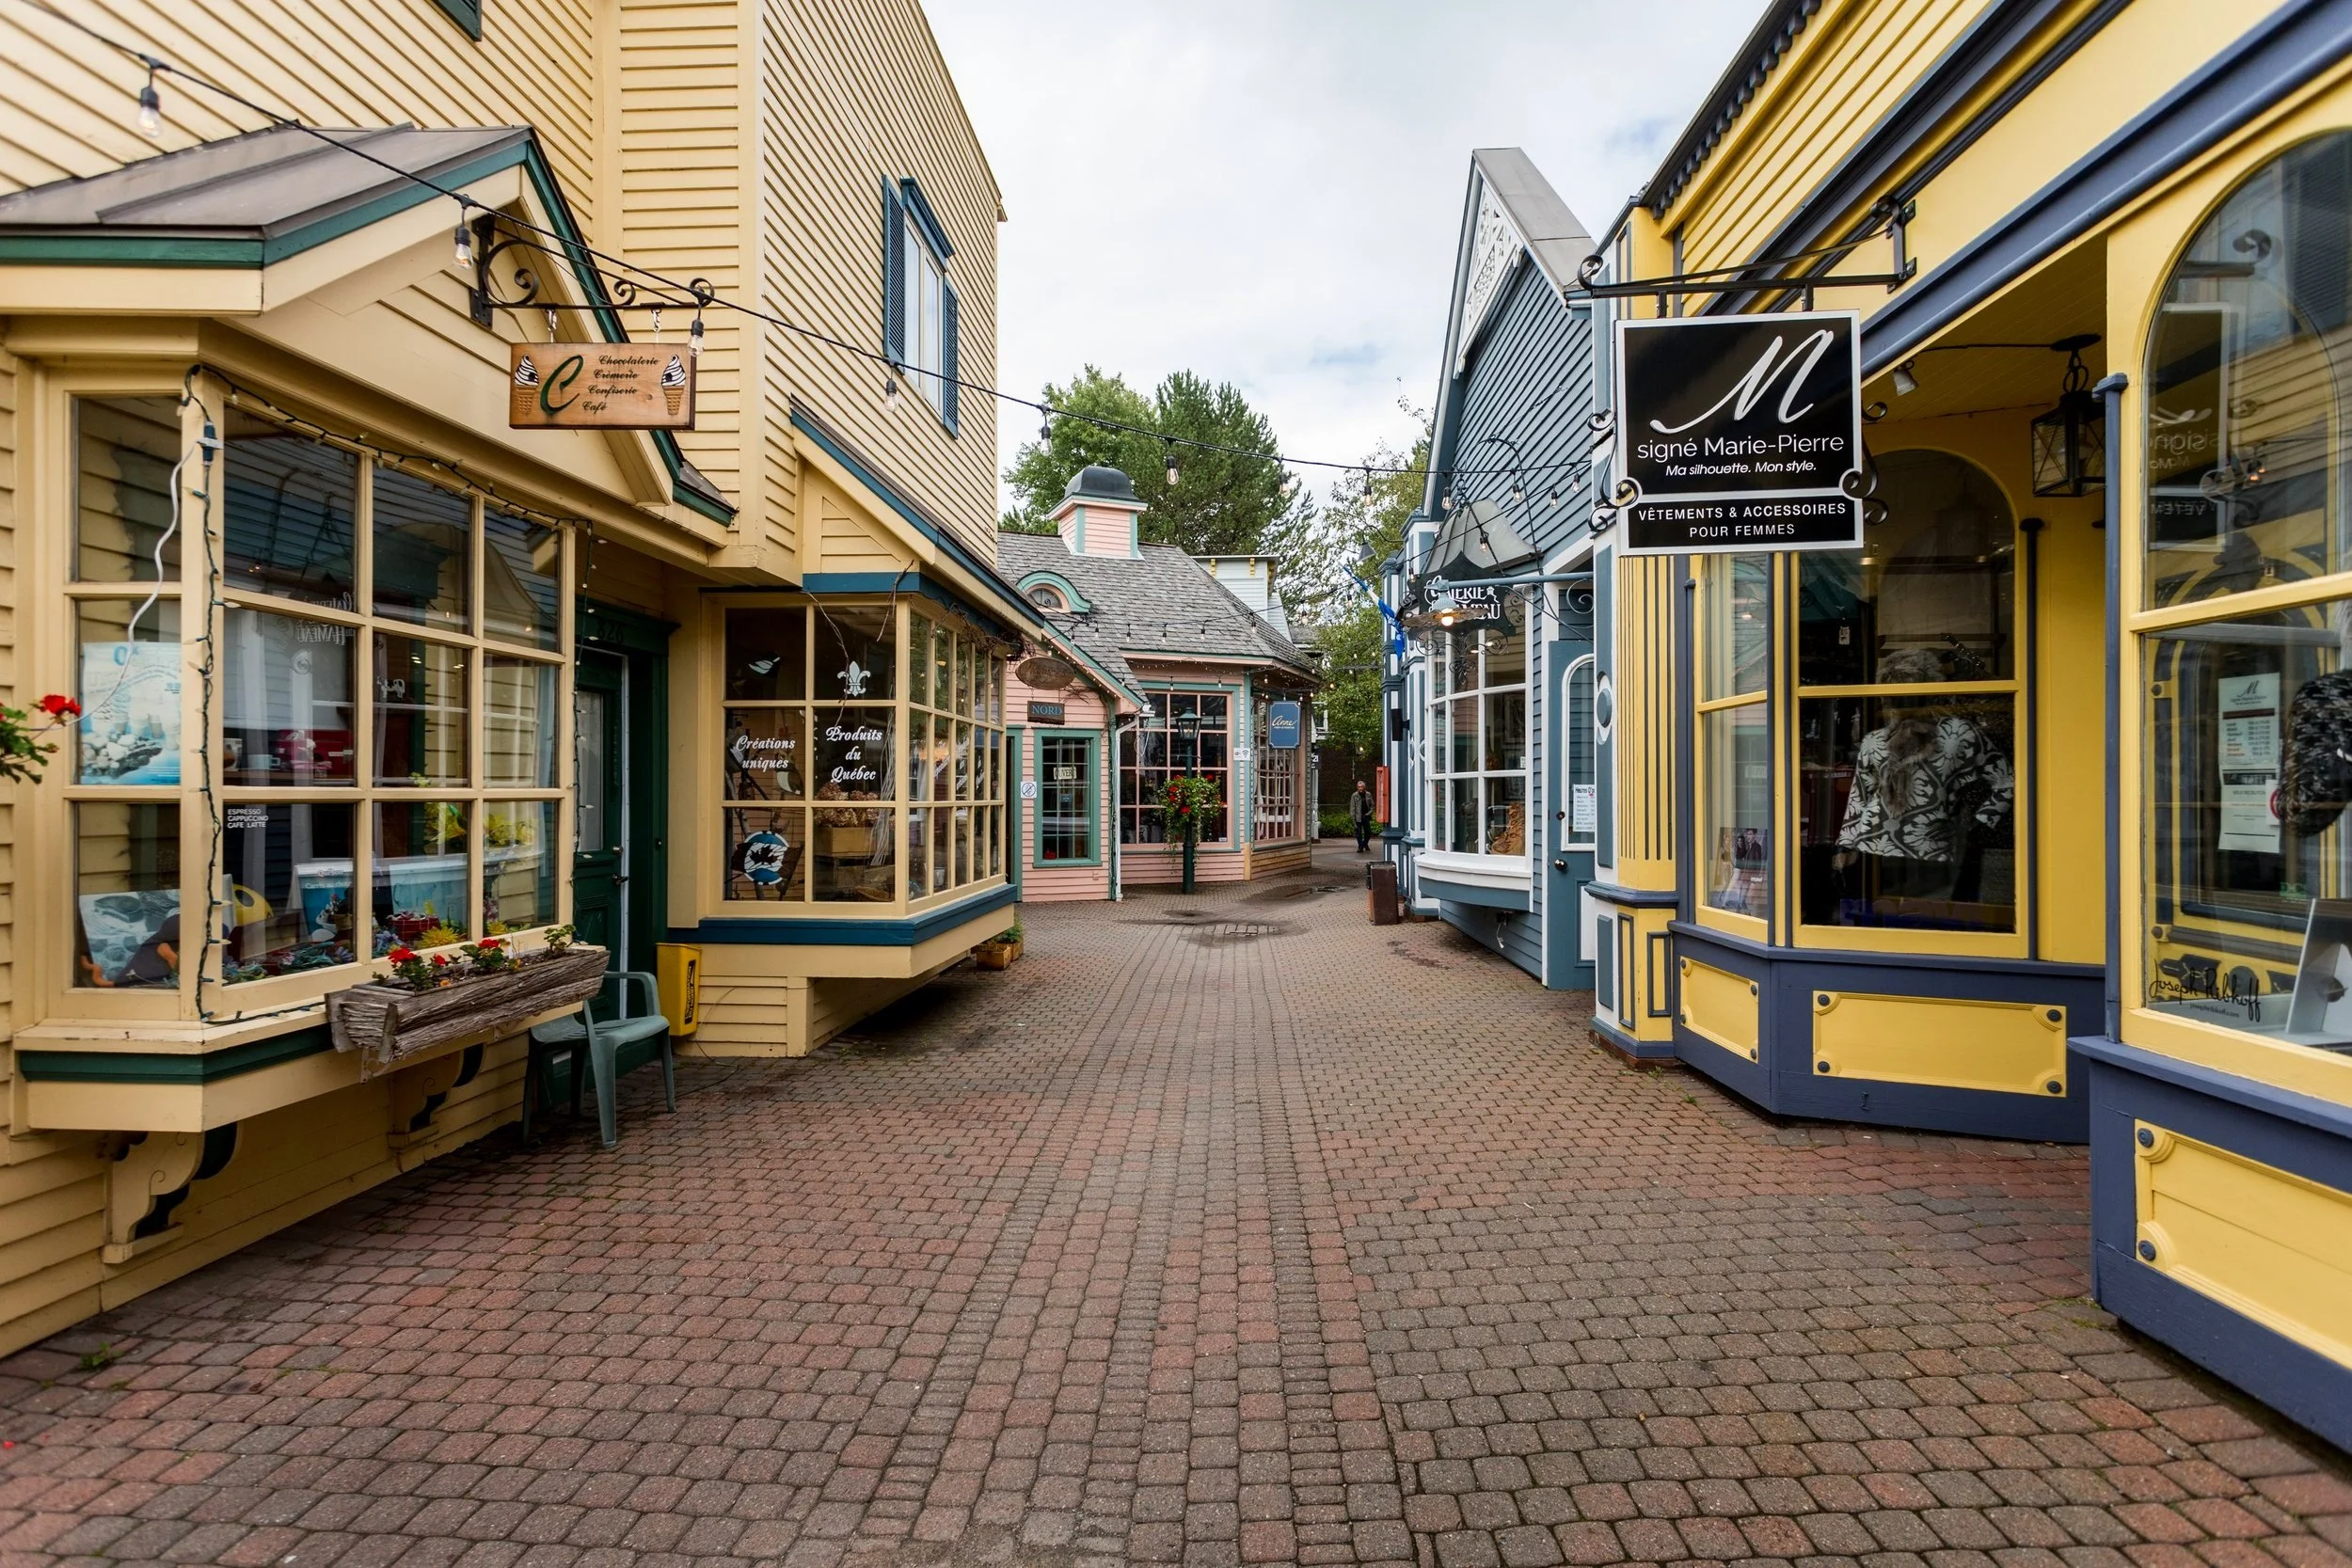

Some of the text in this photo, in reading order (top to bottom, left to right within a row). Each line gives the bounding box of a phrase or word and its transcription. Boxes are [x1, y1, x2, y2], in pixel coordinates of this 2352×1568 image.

[598, 355, 660, 365] Chocolaterie
[540, 354, 584, 415] C
[587, 385, 639, 398] Confiserie
[582, 401, 609, 415] Café
[1637, 434, 1844, 463] signé Marie-Pierre
[1665, 460, 1817, 477] Ma silhouette. Mon style.
[1638, 503, 1846, 520] VÊTEMENTS & ACCESSOIRES
[1690, 524, 1795, 537] POUR FEMMES
[1032, 705, 1062, 715] NORD
[825, 725, 882, 742] Produits
[735, 735, 796, 752] Créations
[845, 746, 862, 761] du
[741, 758, 789, 773] uniques
[831, 766, 877, 784] Québec
[2149, 958, 2261, 1022] Joseph Ribkoff
